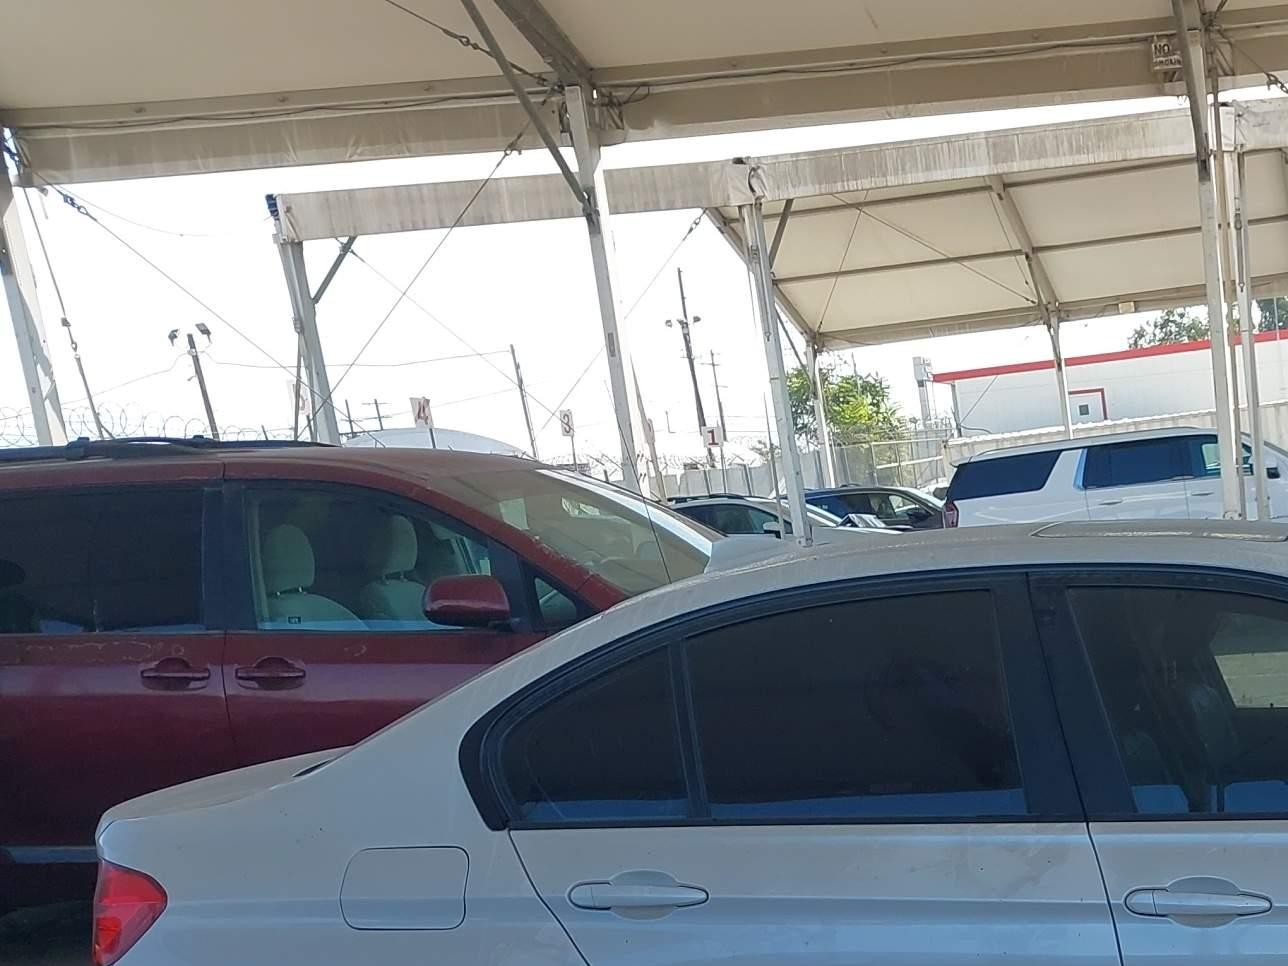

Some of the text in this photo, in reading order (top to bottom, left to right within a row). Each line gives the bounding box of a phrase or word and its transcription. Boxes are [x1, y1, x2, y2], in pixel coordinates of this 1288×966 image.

[1154, 43, 1170, 55] NO
[563, 412, 571, 434] 3
[707, 428, 719, 446] 1
